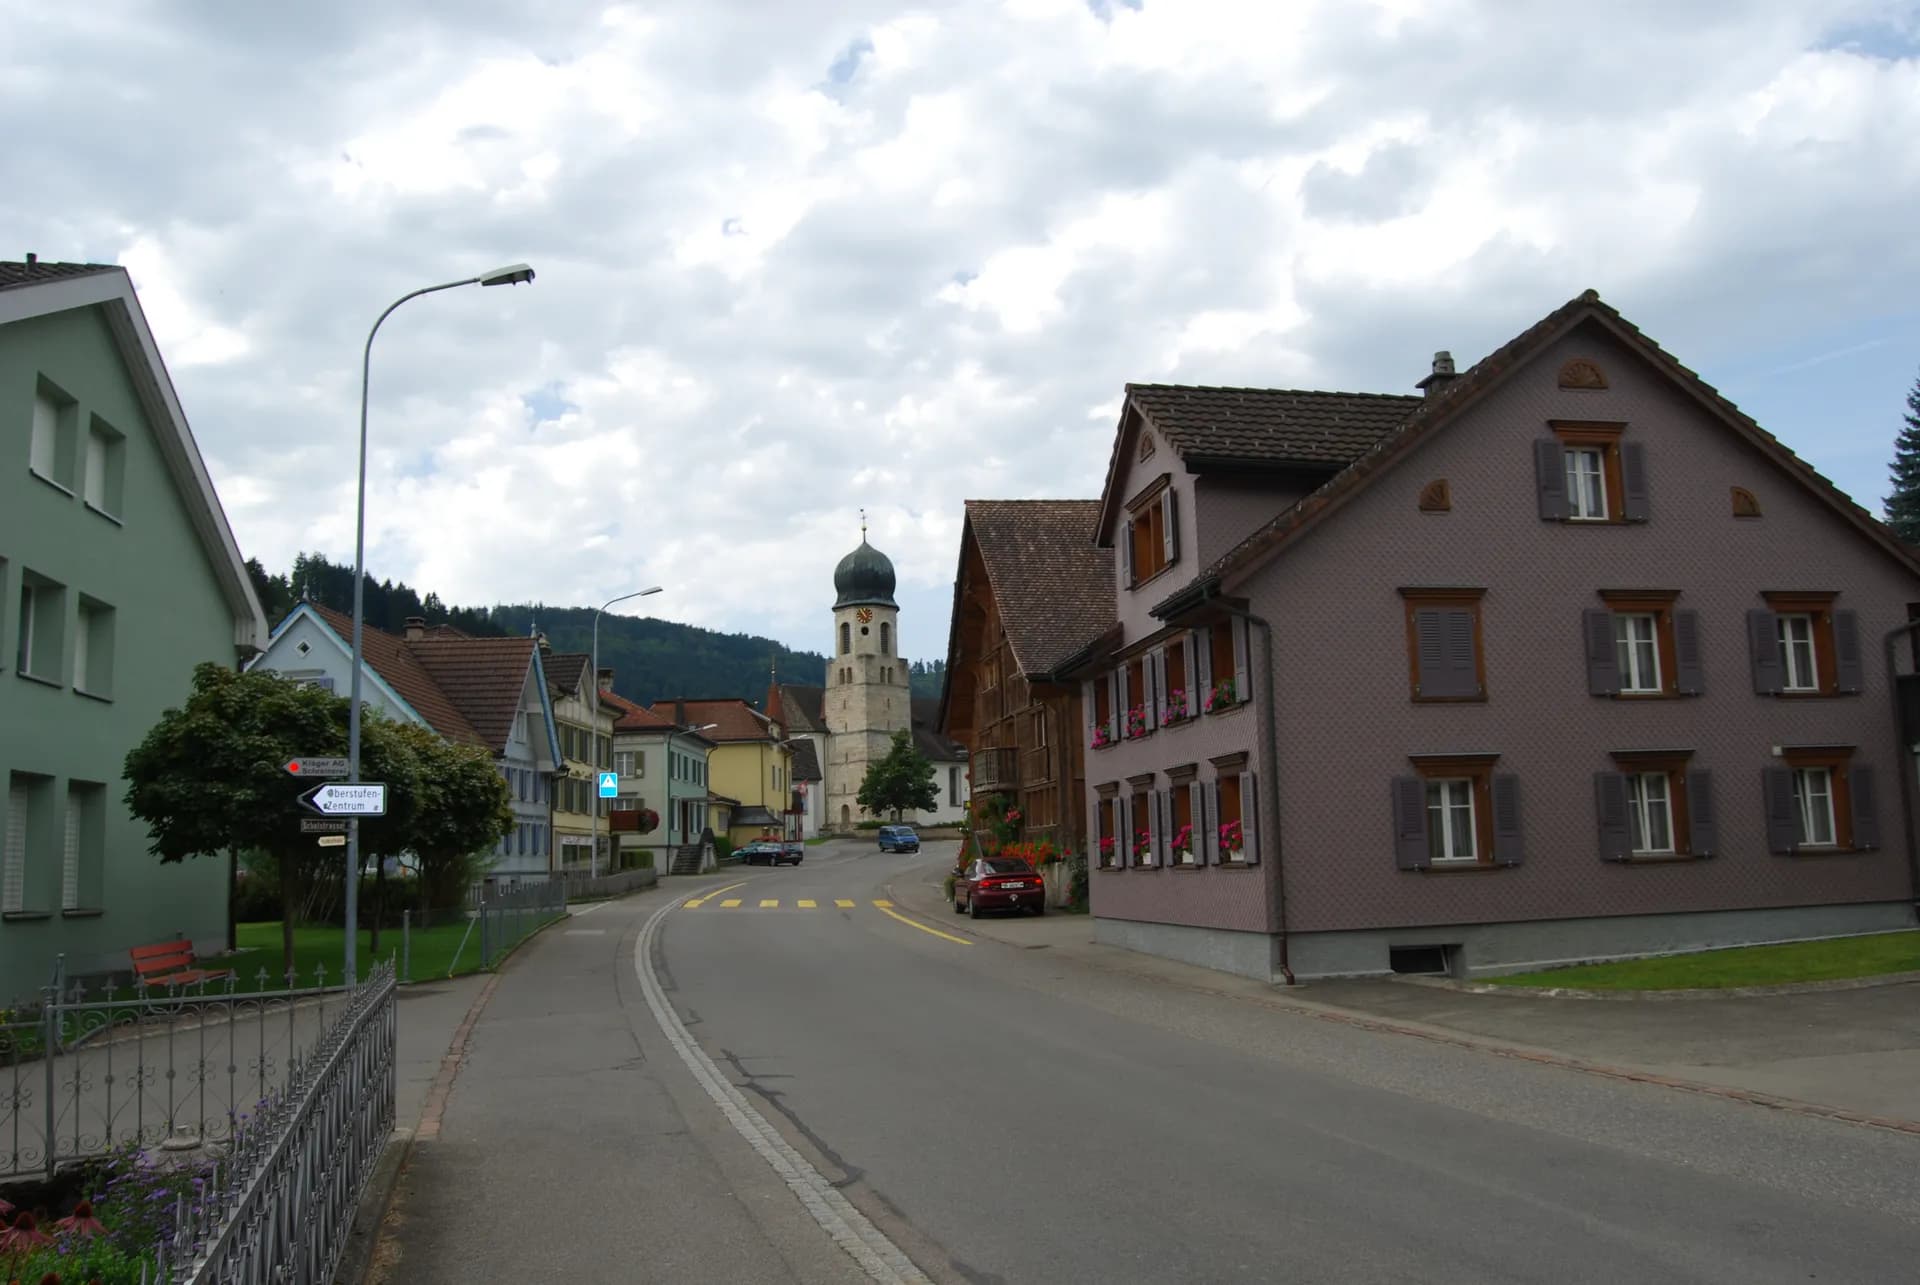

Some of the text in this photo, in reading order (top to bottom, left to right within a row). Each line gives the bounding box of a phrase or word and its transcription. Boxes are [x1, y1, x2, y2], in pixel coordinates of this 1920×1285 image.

[332, 759, 346, 767] AG
[327, 788, 381, 799] Oberstufen-
[327, 801, 365, 811] Zentrum
